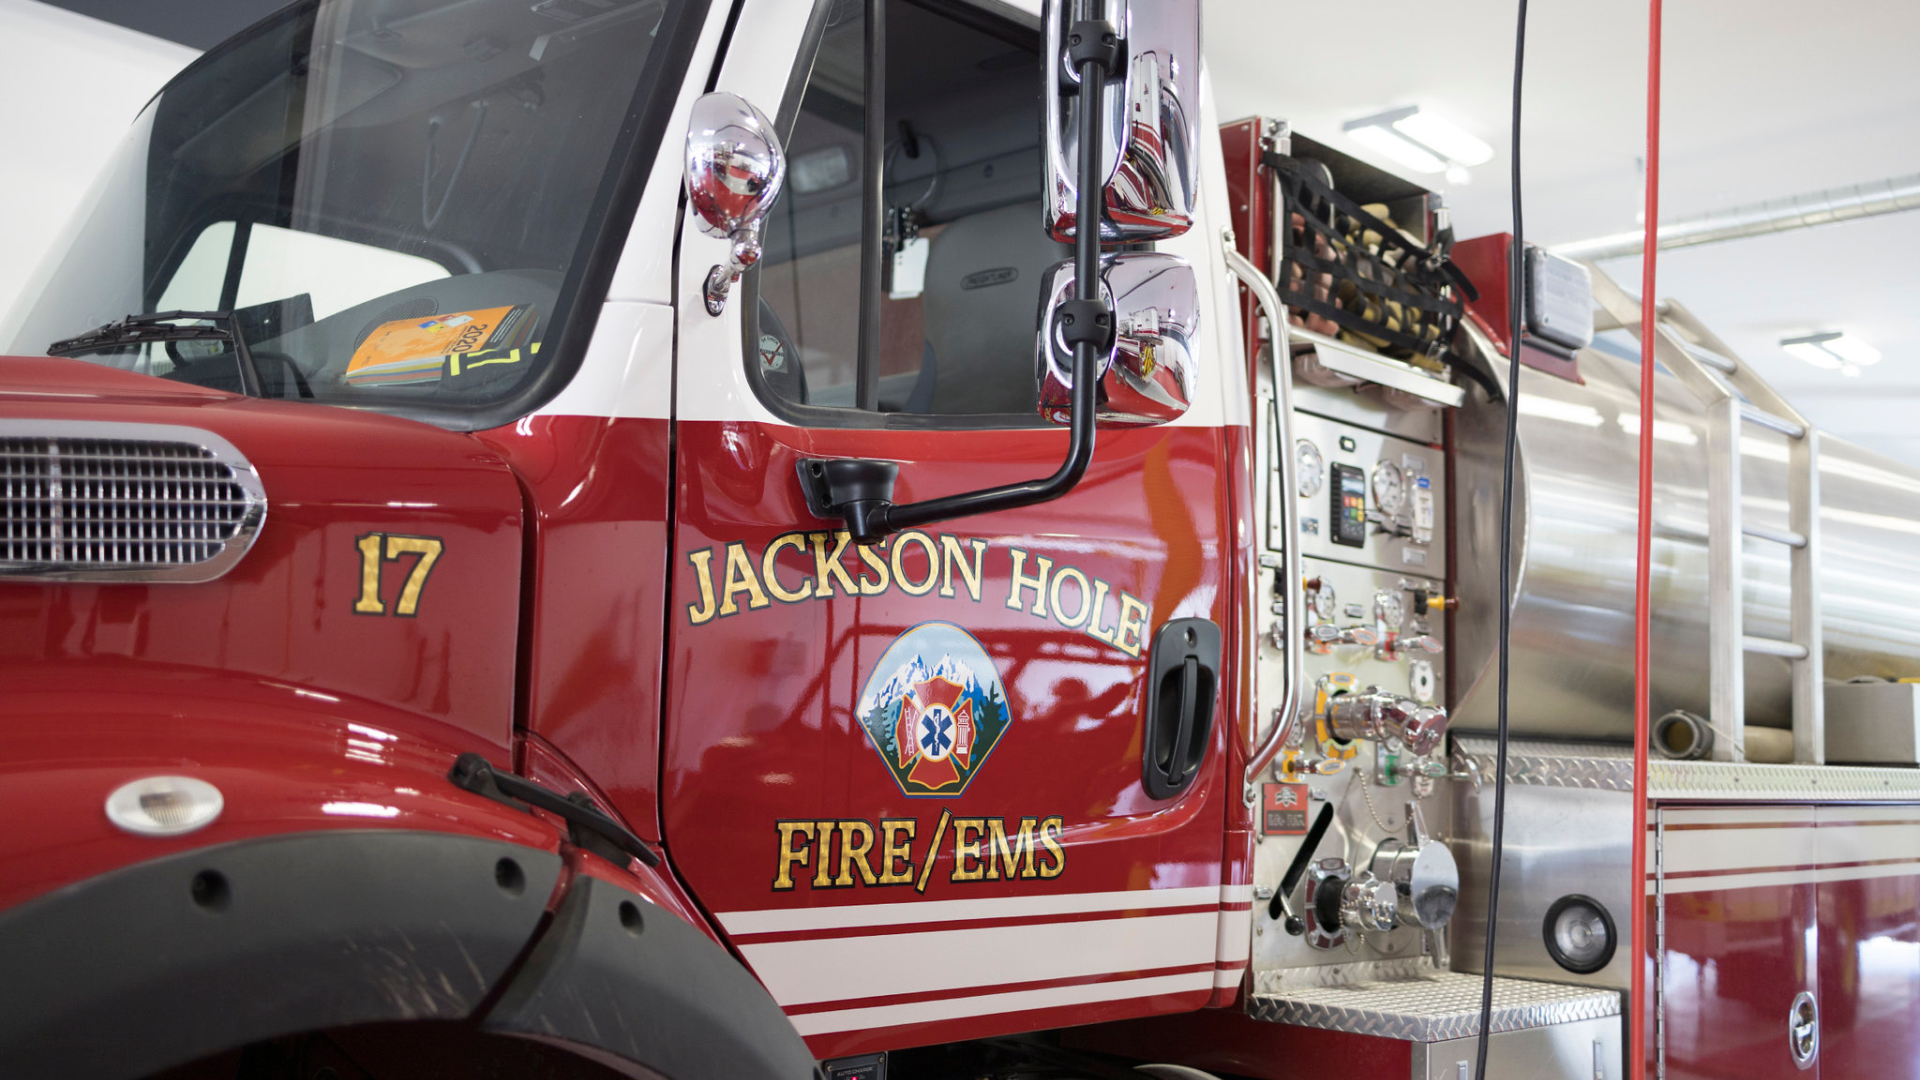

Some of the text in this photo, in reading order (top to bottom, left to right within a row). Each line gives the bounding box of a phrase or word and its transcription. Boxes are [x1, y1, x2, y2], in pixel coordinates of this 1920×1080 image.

[452, 324, 488, 352] 2020
[352, 531, 446, 618] 17
[688, 529, 1150, 661] JACKSON HOLE
[771, 807, 1067, 895] FIRE/EMS
